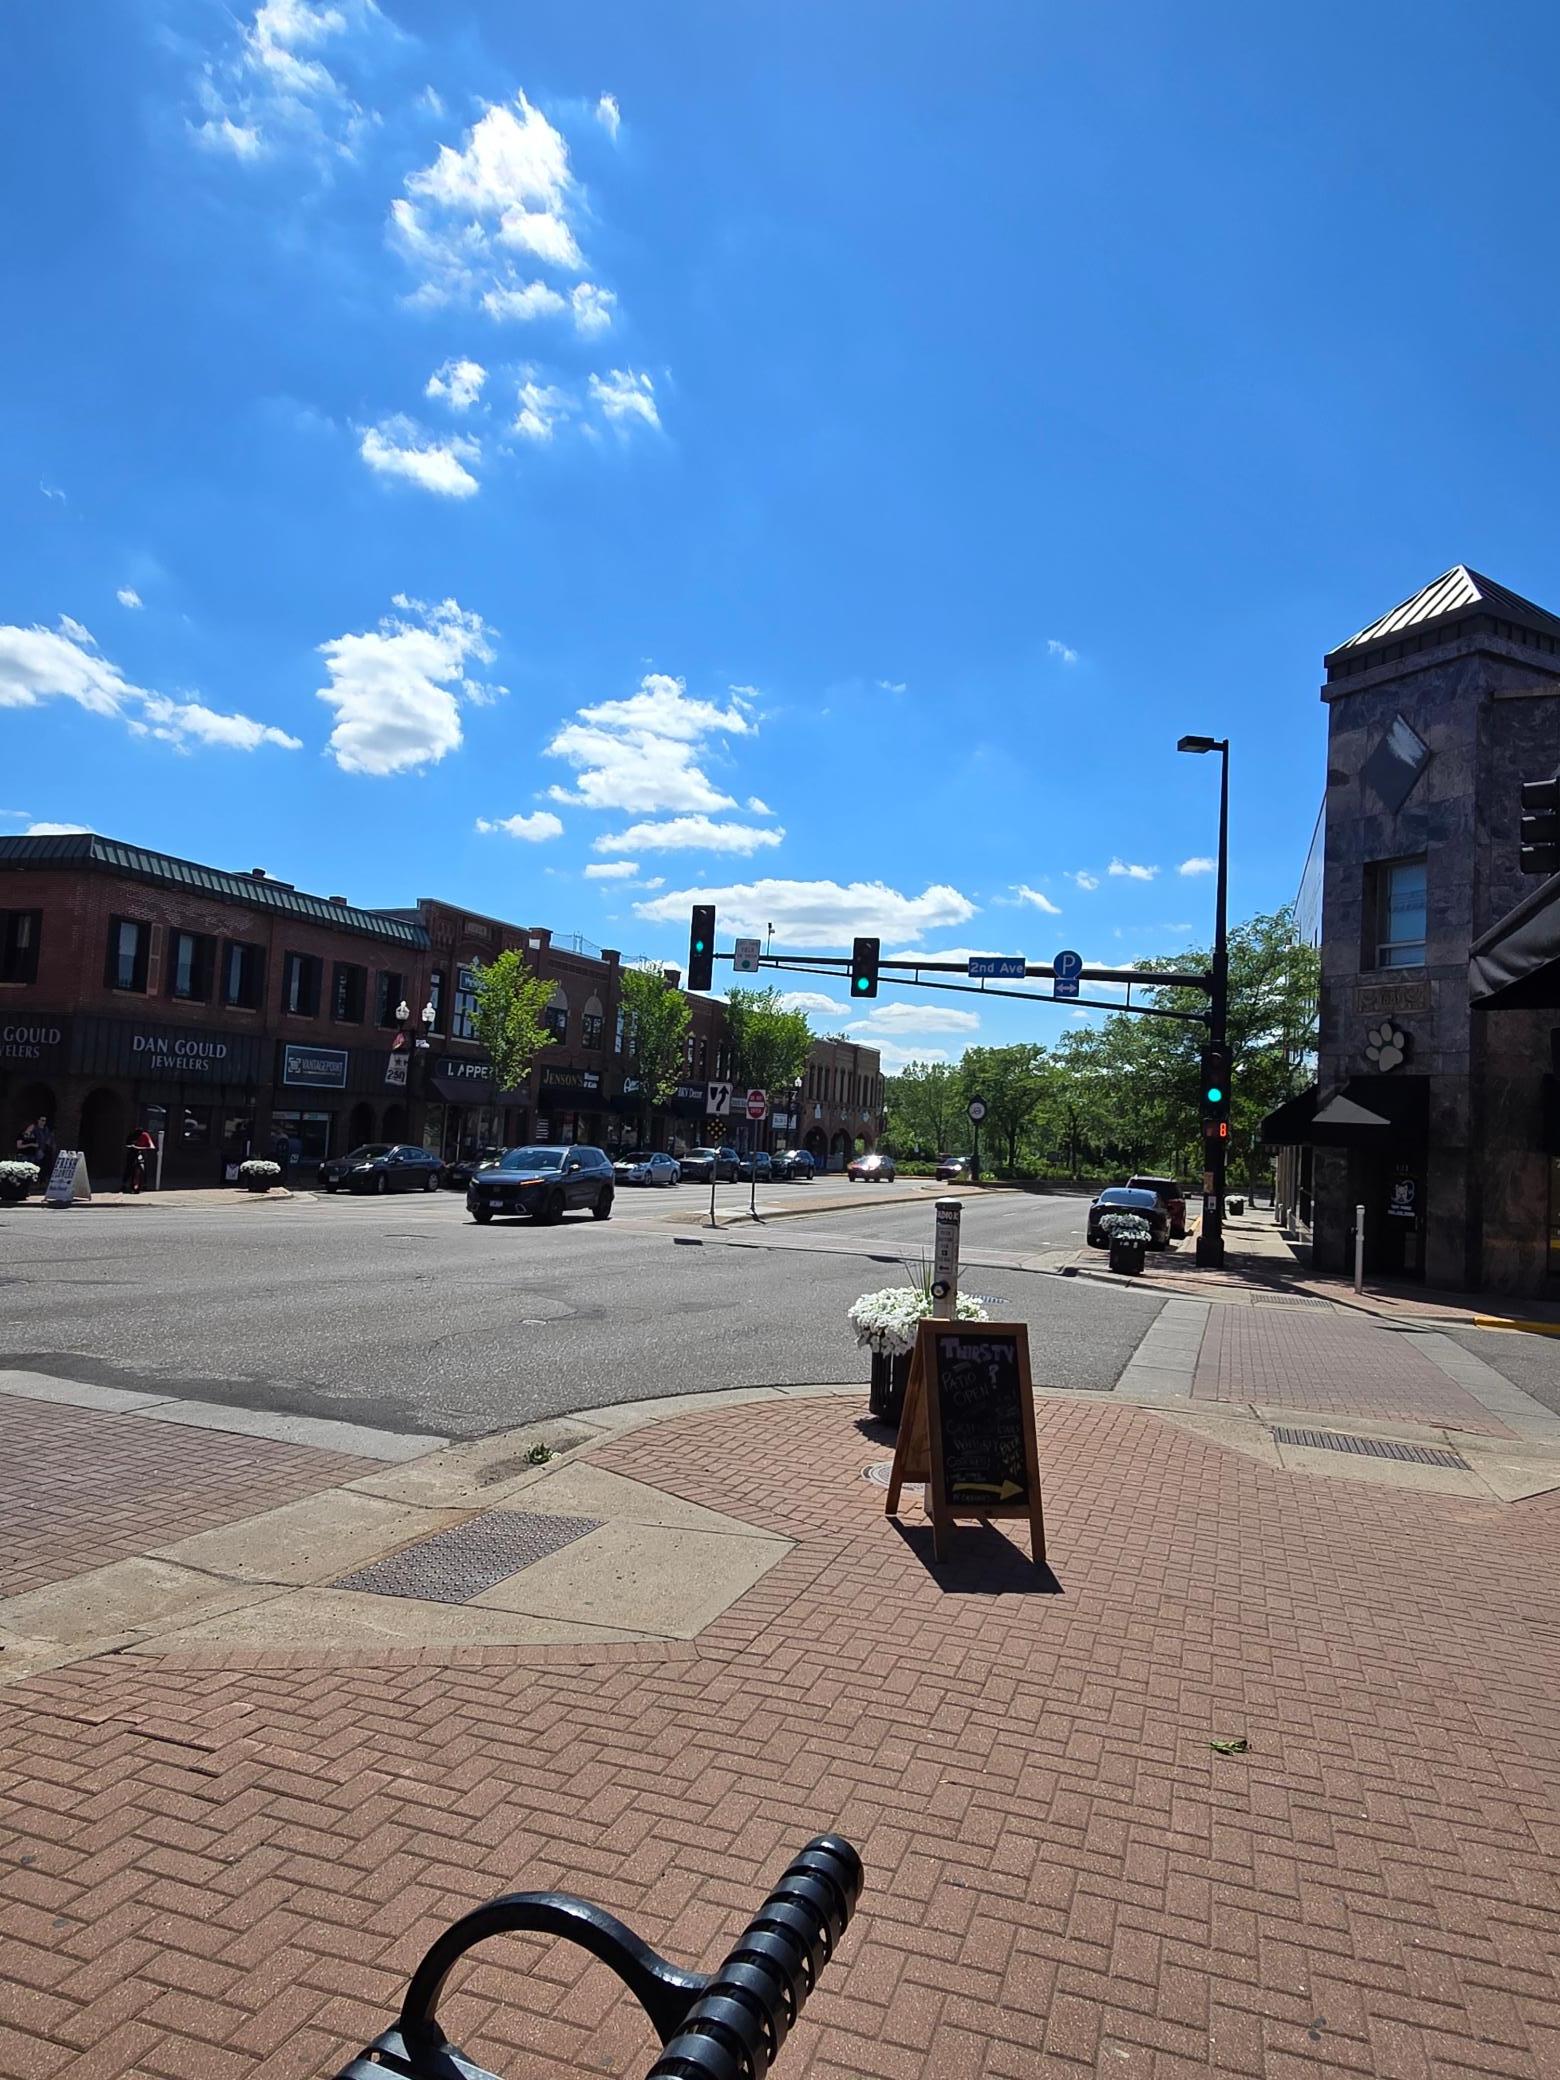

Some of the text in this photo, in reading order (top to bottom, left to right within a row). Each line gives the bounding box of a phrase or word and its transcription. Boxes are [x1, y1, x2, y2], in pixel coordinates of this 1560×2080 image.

[970, 962, 1024, 974] 2nd Ave
[1063, 955, 1076, 975] P
[3, 1026, 62, 1045] GOULD
[133, 1035, 227, 1059] DAN GOULD
[150, 1055, 210, 1071] JEWELERS
[1219, 1122, 1227, 1138] 8
[940, 1336, 1014, 1364] THIRSTY
[942, 1371, 977, 1393] PATIO
